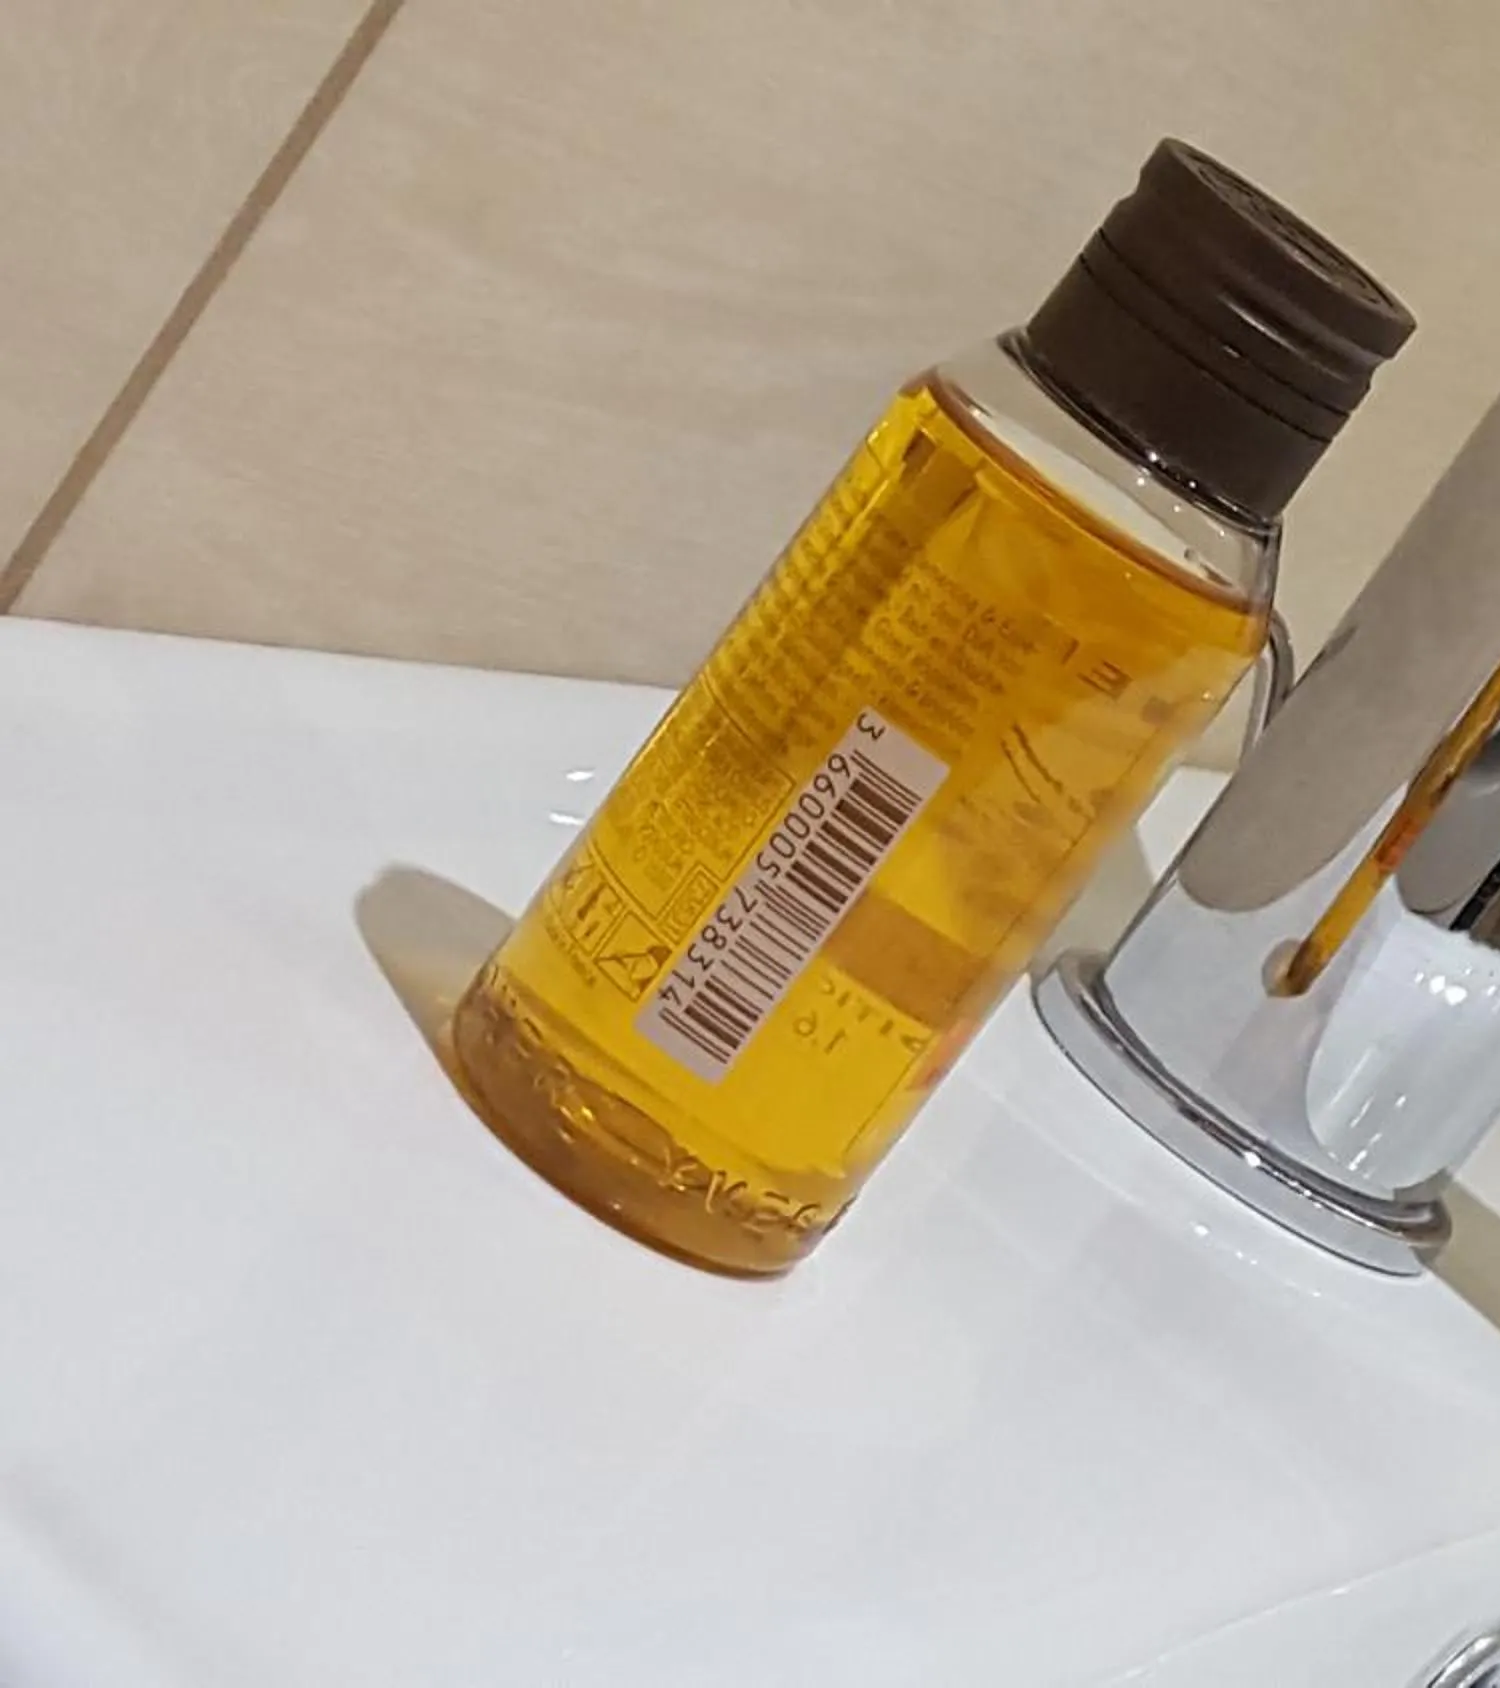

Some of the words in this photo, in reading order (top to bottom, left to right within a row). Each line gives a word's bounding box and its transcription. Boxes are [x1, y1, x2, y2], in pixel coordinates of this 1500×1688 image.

[856, 711, 885, 741] 3
[756, 753, 851, 879] 660005
[657, 886, 758, 1007] 738314
